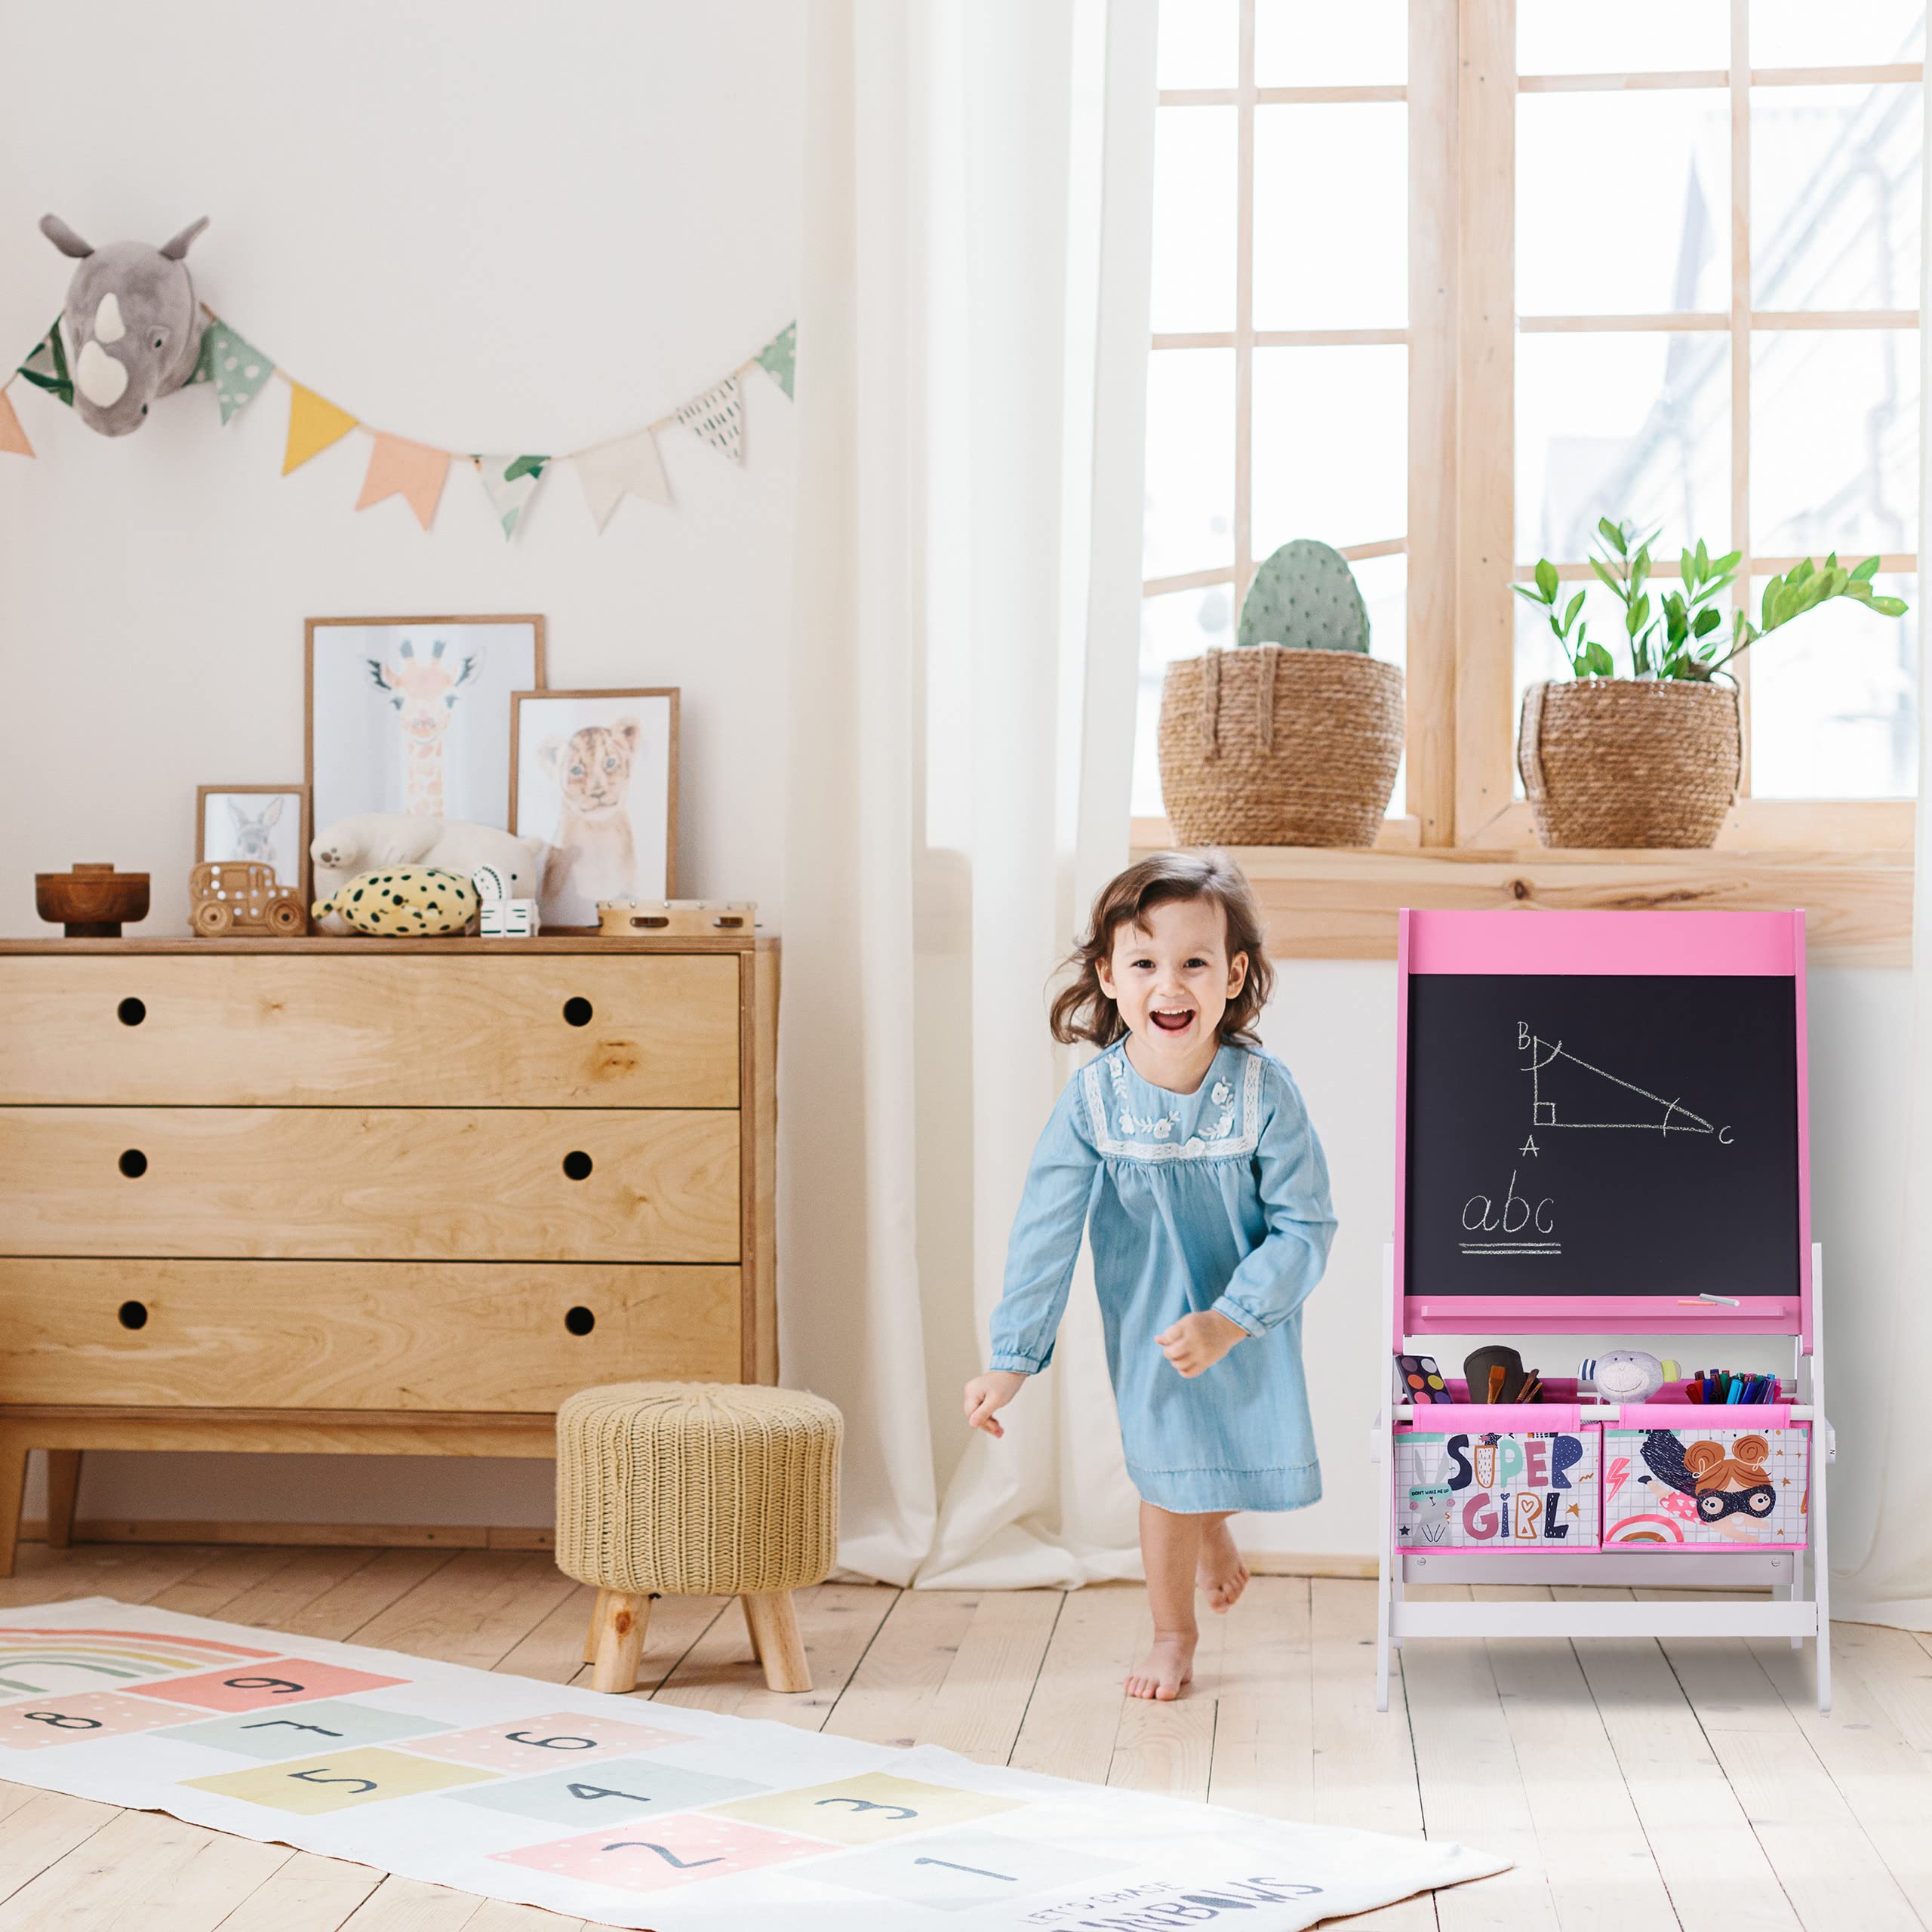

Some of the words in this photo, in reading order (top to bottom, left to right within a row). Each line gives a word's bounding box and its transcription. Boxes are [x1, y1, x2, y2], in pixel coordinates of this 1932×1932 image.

[1517, 1021, 1531, 1050] B
[1518, 1135, 1540, 1157] A
[1719, 1126, 1734, 1144] C
[1463, 1170, 1555, 1233] abc
[1447, 1434, 1583, 1491] SUPER
[223, 1677, 305, 1694] 9
[23, 1712, 103, 1730] 8
[240, 1719, 343, 1737] 7
[505, 1731, 597, 1750] 6
[288, 1768, 377, 1794] 5
[567, 1782, 651, 1802] 4
[814, 1798, 918, 1820] 3
[601, 1841, 726, 1869] 2
[914, 1857, 1018, 1881] 1
[1017, 1902, 1095, 1925] LET'S
[1089, 1881, 1185, 1903] CHASE
